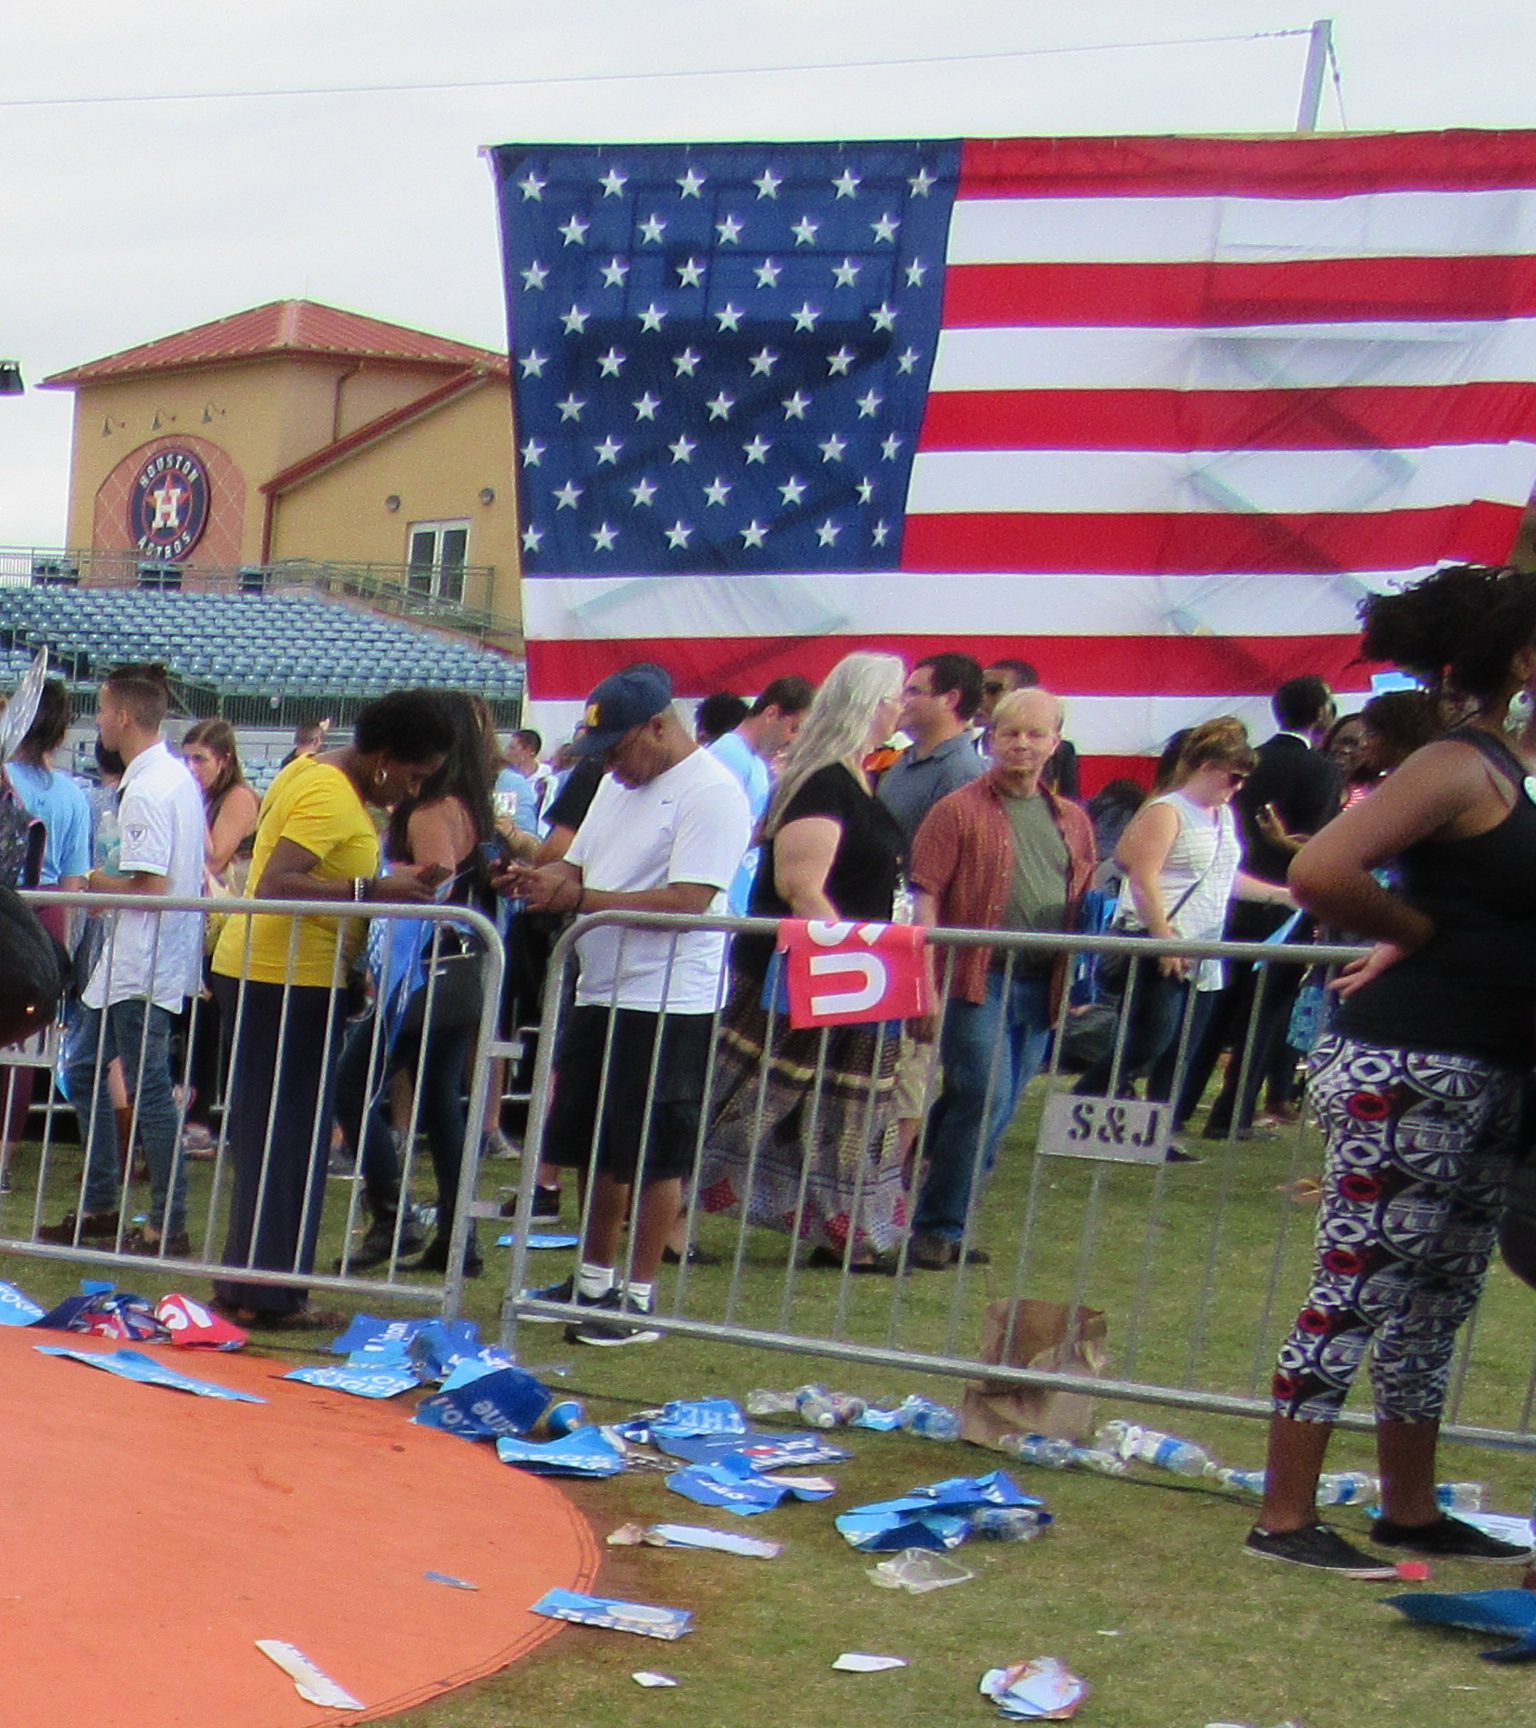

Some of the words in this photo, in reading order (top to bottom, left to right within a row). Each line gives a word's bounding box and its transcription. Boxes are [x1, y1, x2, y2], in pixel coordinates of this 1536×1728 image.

[138, 454, 199, 488] HOUSTON
[152, 487, 182, 530] H
[137, 530, 191, 559] ASTROS
[1067, 1102, 1159, 1148] S&J
